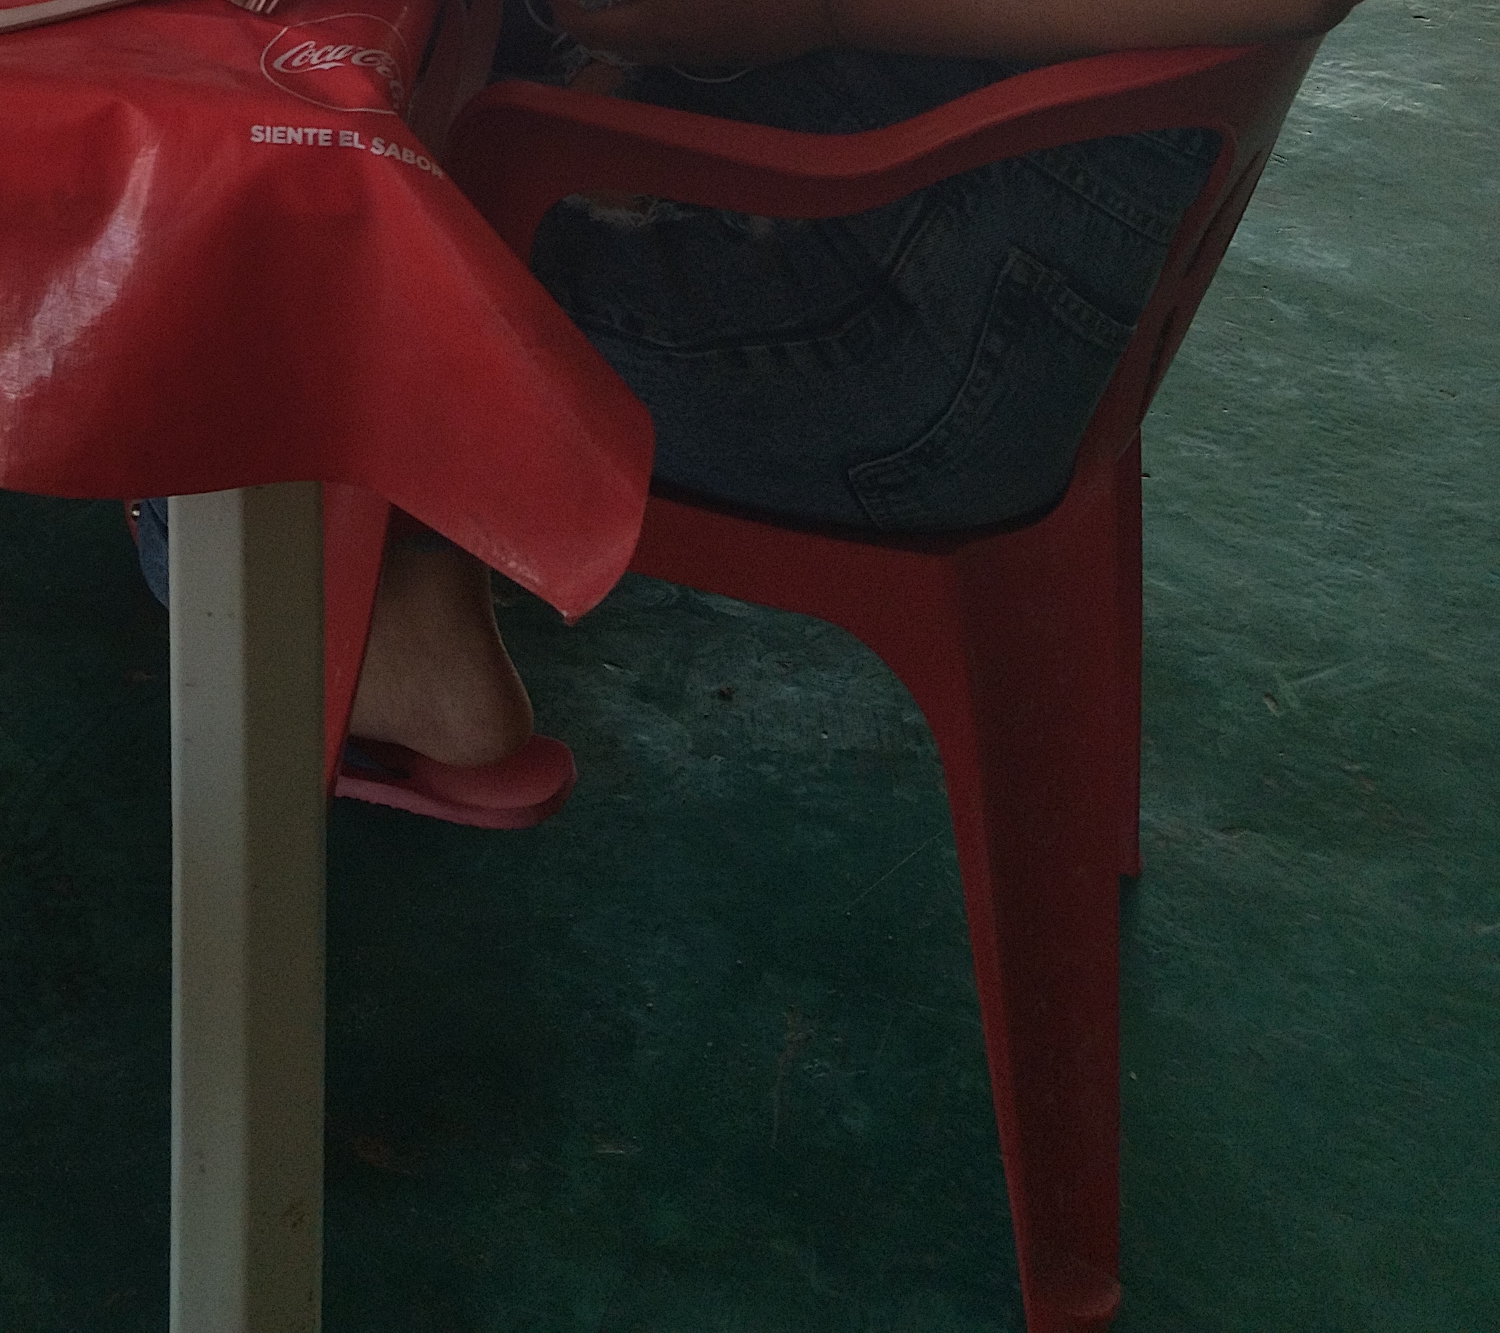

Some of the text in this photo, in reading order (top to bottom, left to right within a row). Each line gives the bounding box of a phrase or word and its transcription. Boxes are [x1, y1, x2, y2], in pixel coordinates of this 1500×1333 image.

[250, 125, 446, 180] SIENTE EL SABOR
